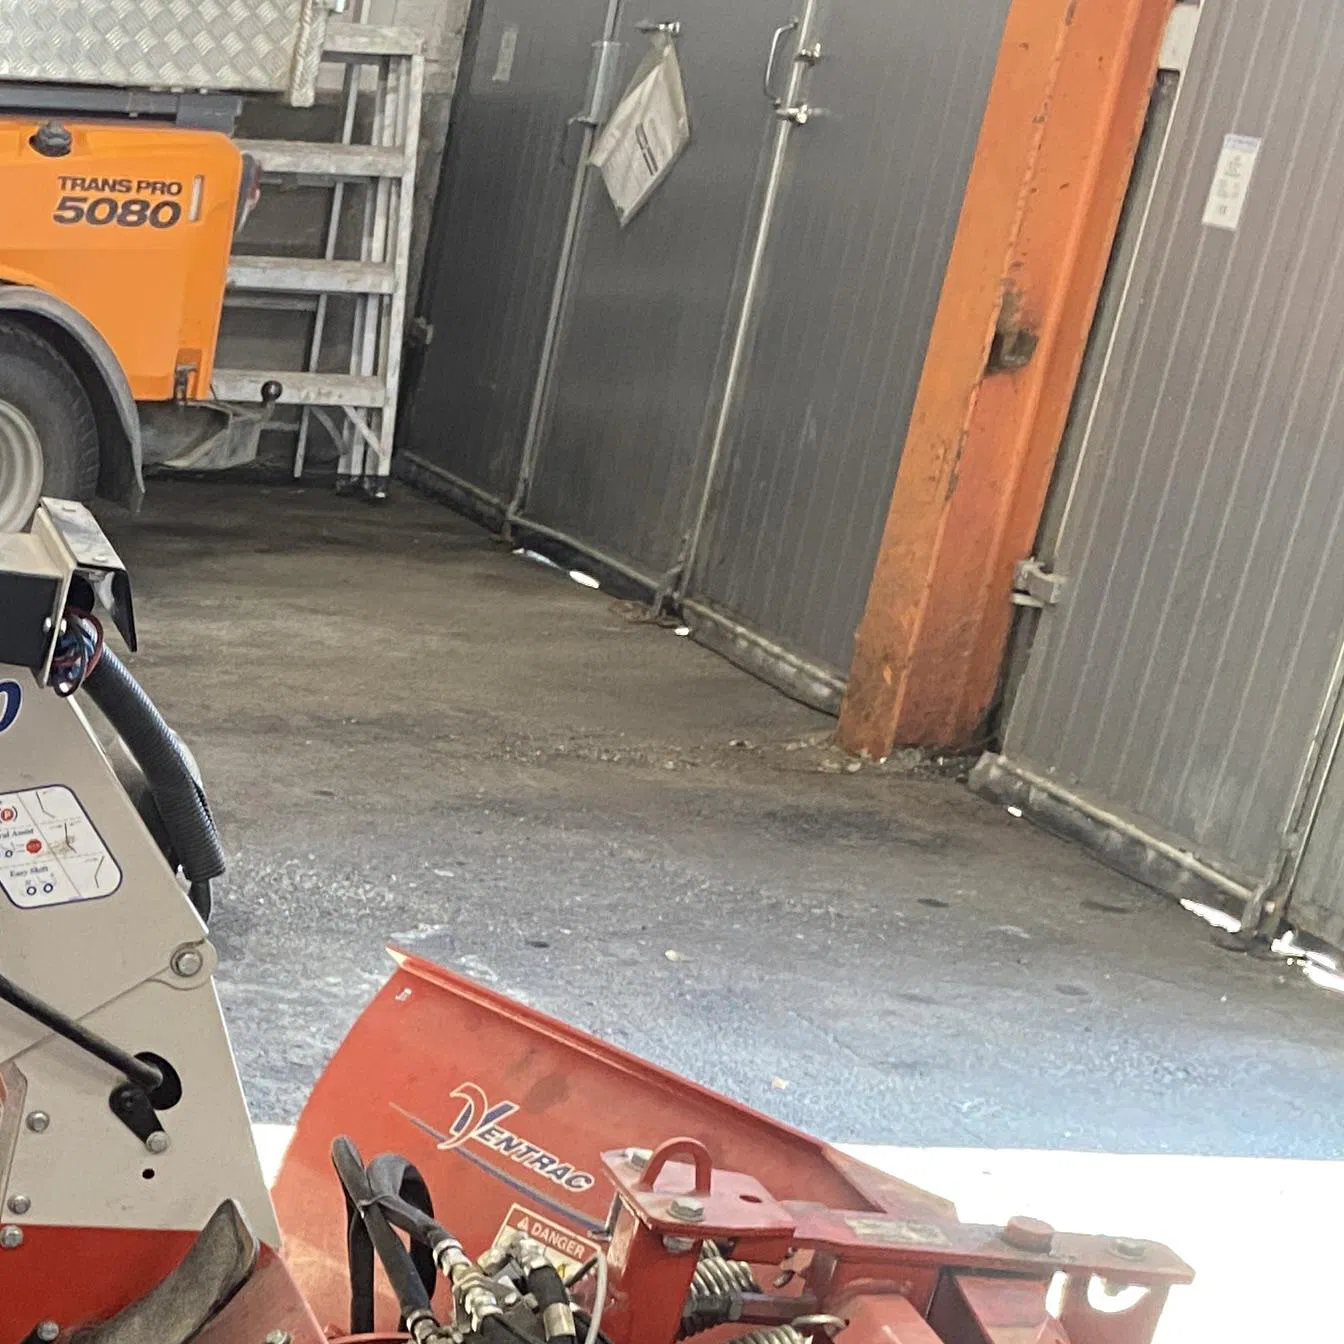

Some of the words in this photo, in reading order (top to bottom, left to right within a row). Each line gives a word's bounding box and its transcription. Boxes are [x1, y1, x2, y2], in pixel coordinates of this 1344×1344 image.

[58, 176, 132, 194] TRANS
[136, 180, 182, 196] PRO
[53, 196, 182, 229] 5080
[437, 1082, 595, 1192] VENTRAC
[531, 1222, 585, 1259] DANGER
